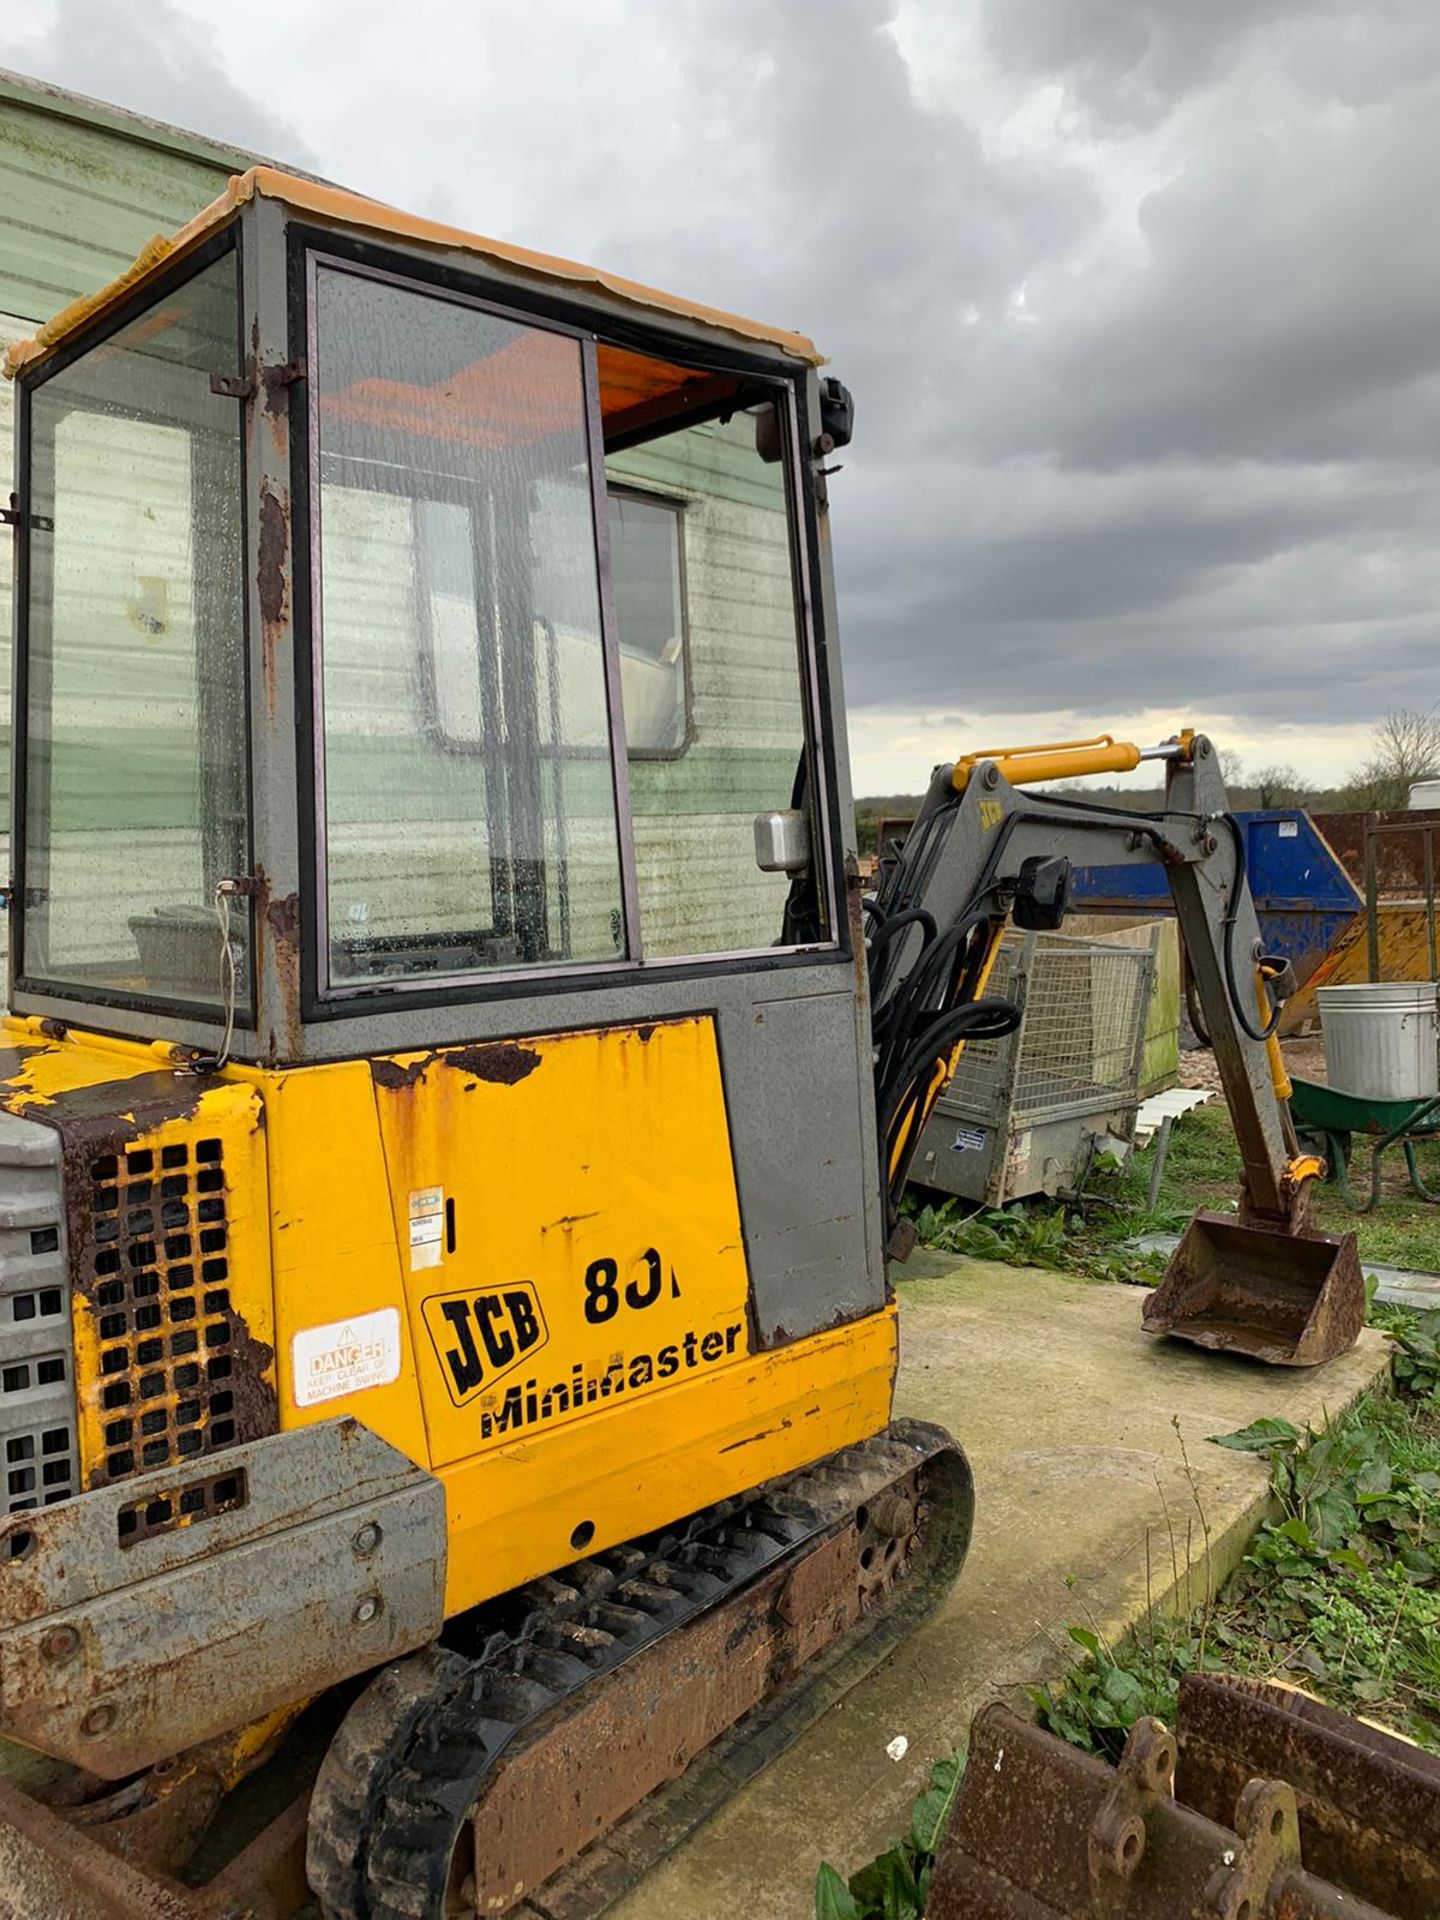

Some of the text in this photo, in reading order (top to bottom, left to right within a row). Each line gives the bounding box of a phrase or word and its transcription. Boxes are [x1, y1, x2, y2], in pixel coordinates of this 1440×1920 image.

[441, 1291, 539, 1396] JCB
[311, 1342, 384, 1374] DANGER
[337, 1362, 369, 1380] CLEAR
[307, 1380, 351, 1401] MACHINE
